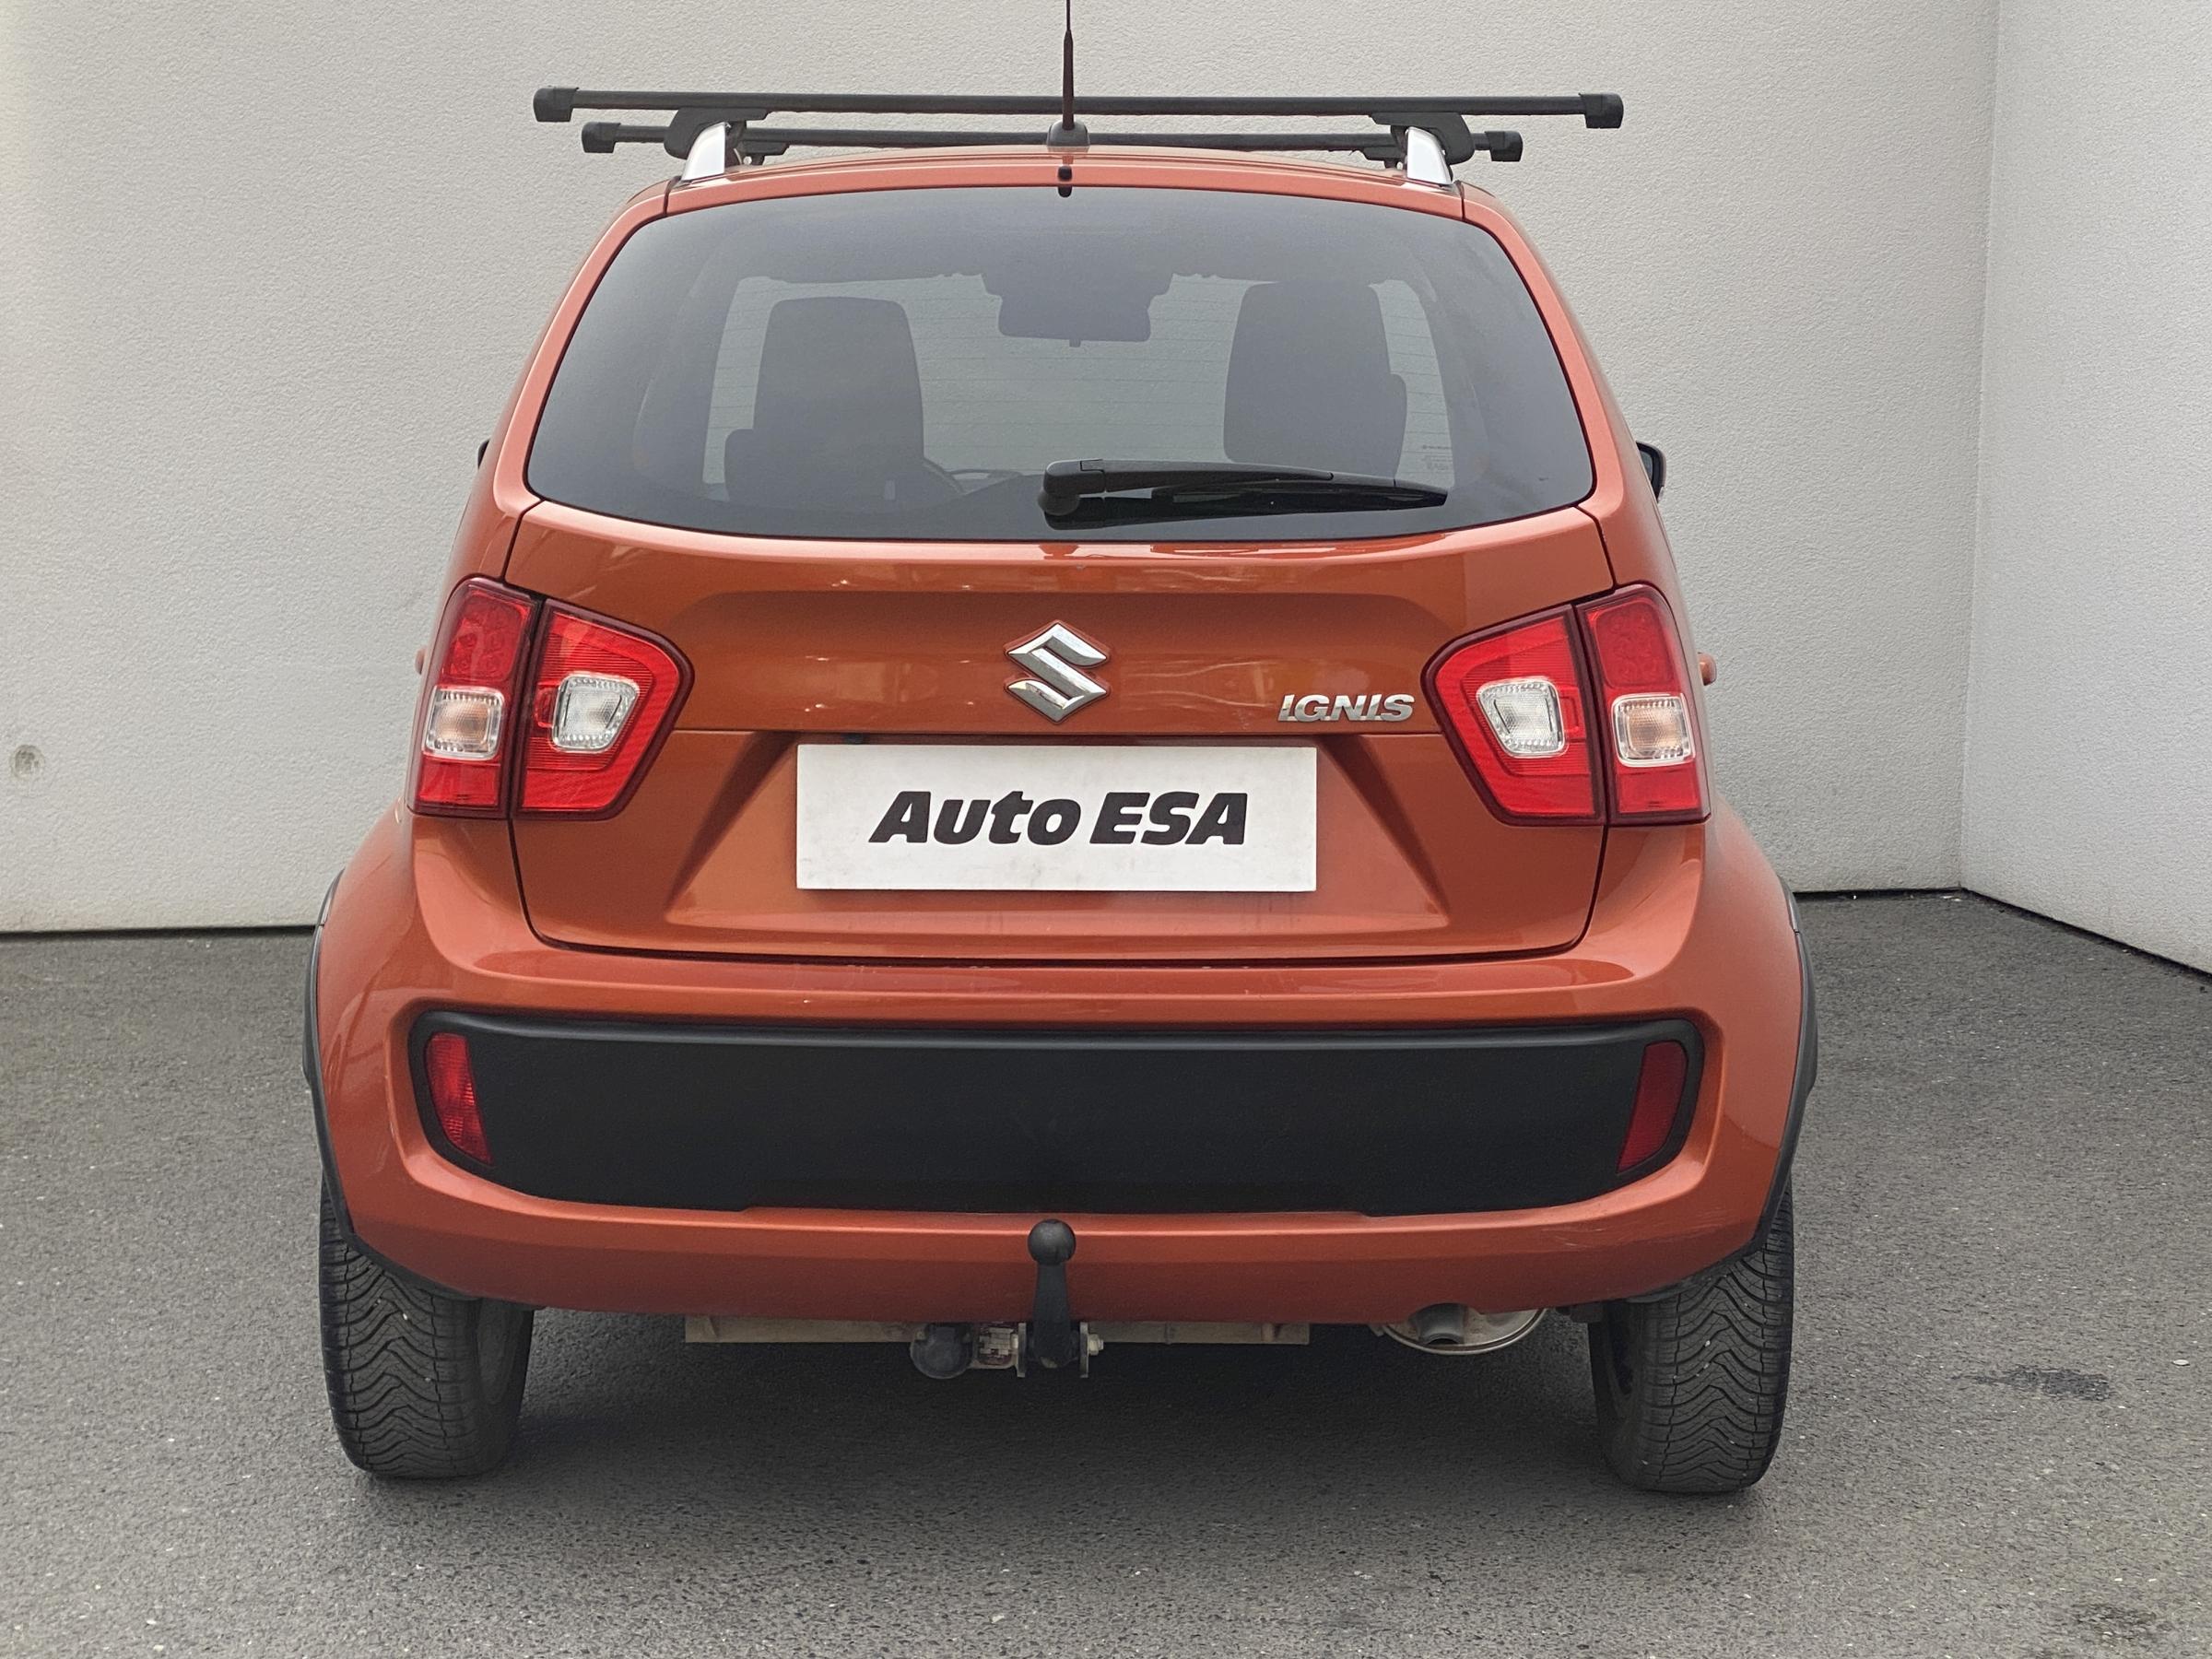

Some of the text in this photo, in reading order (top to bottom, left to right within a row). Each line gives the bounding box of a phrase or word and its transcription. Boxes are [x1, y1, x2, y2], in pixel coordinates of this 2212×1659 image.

[1277, 693, 1416, 723] IGNIS
[868, 790, 1248, 846] Auto ESA
